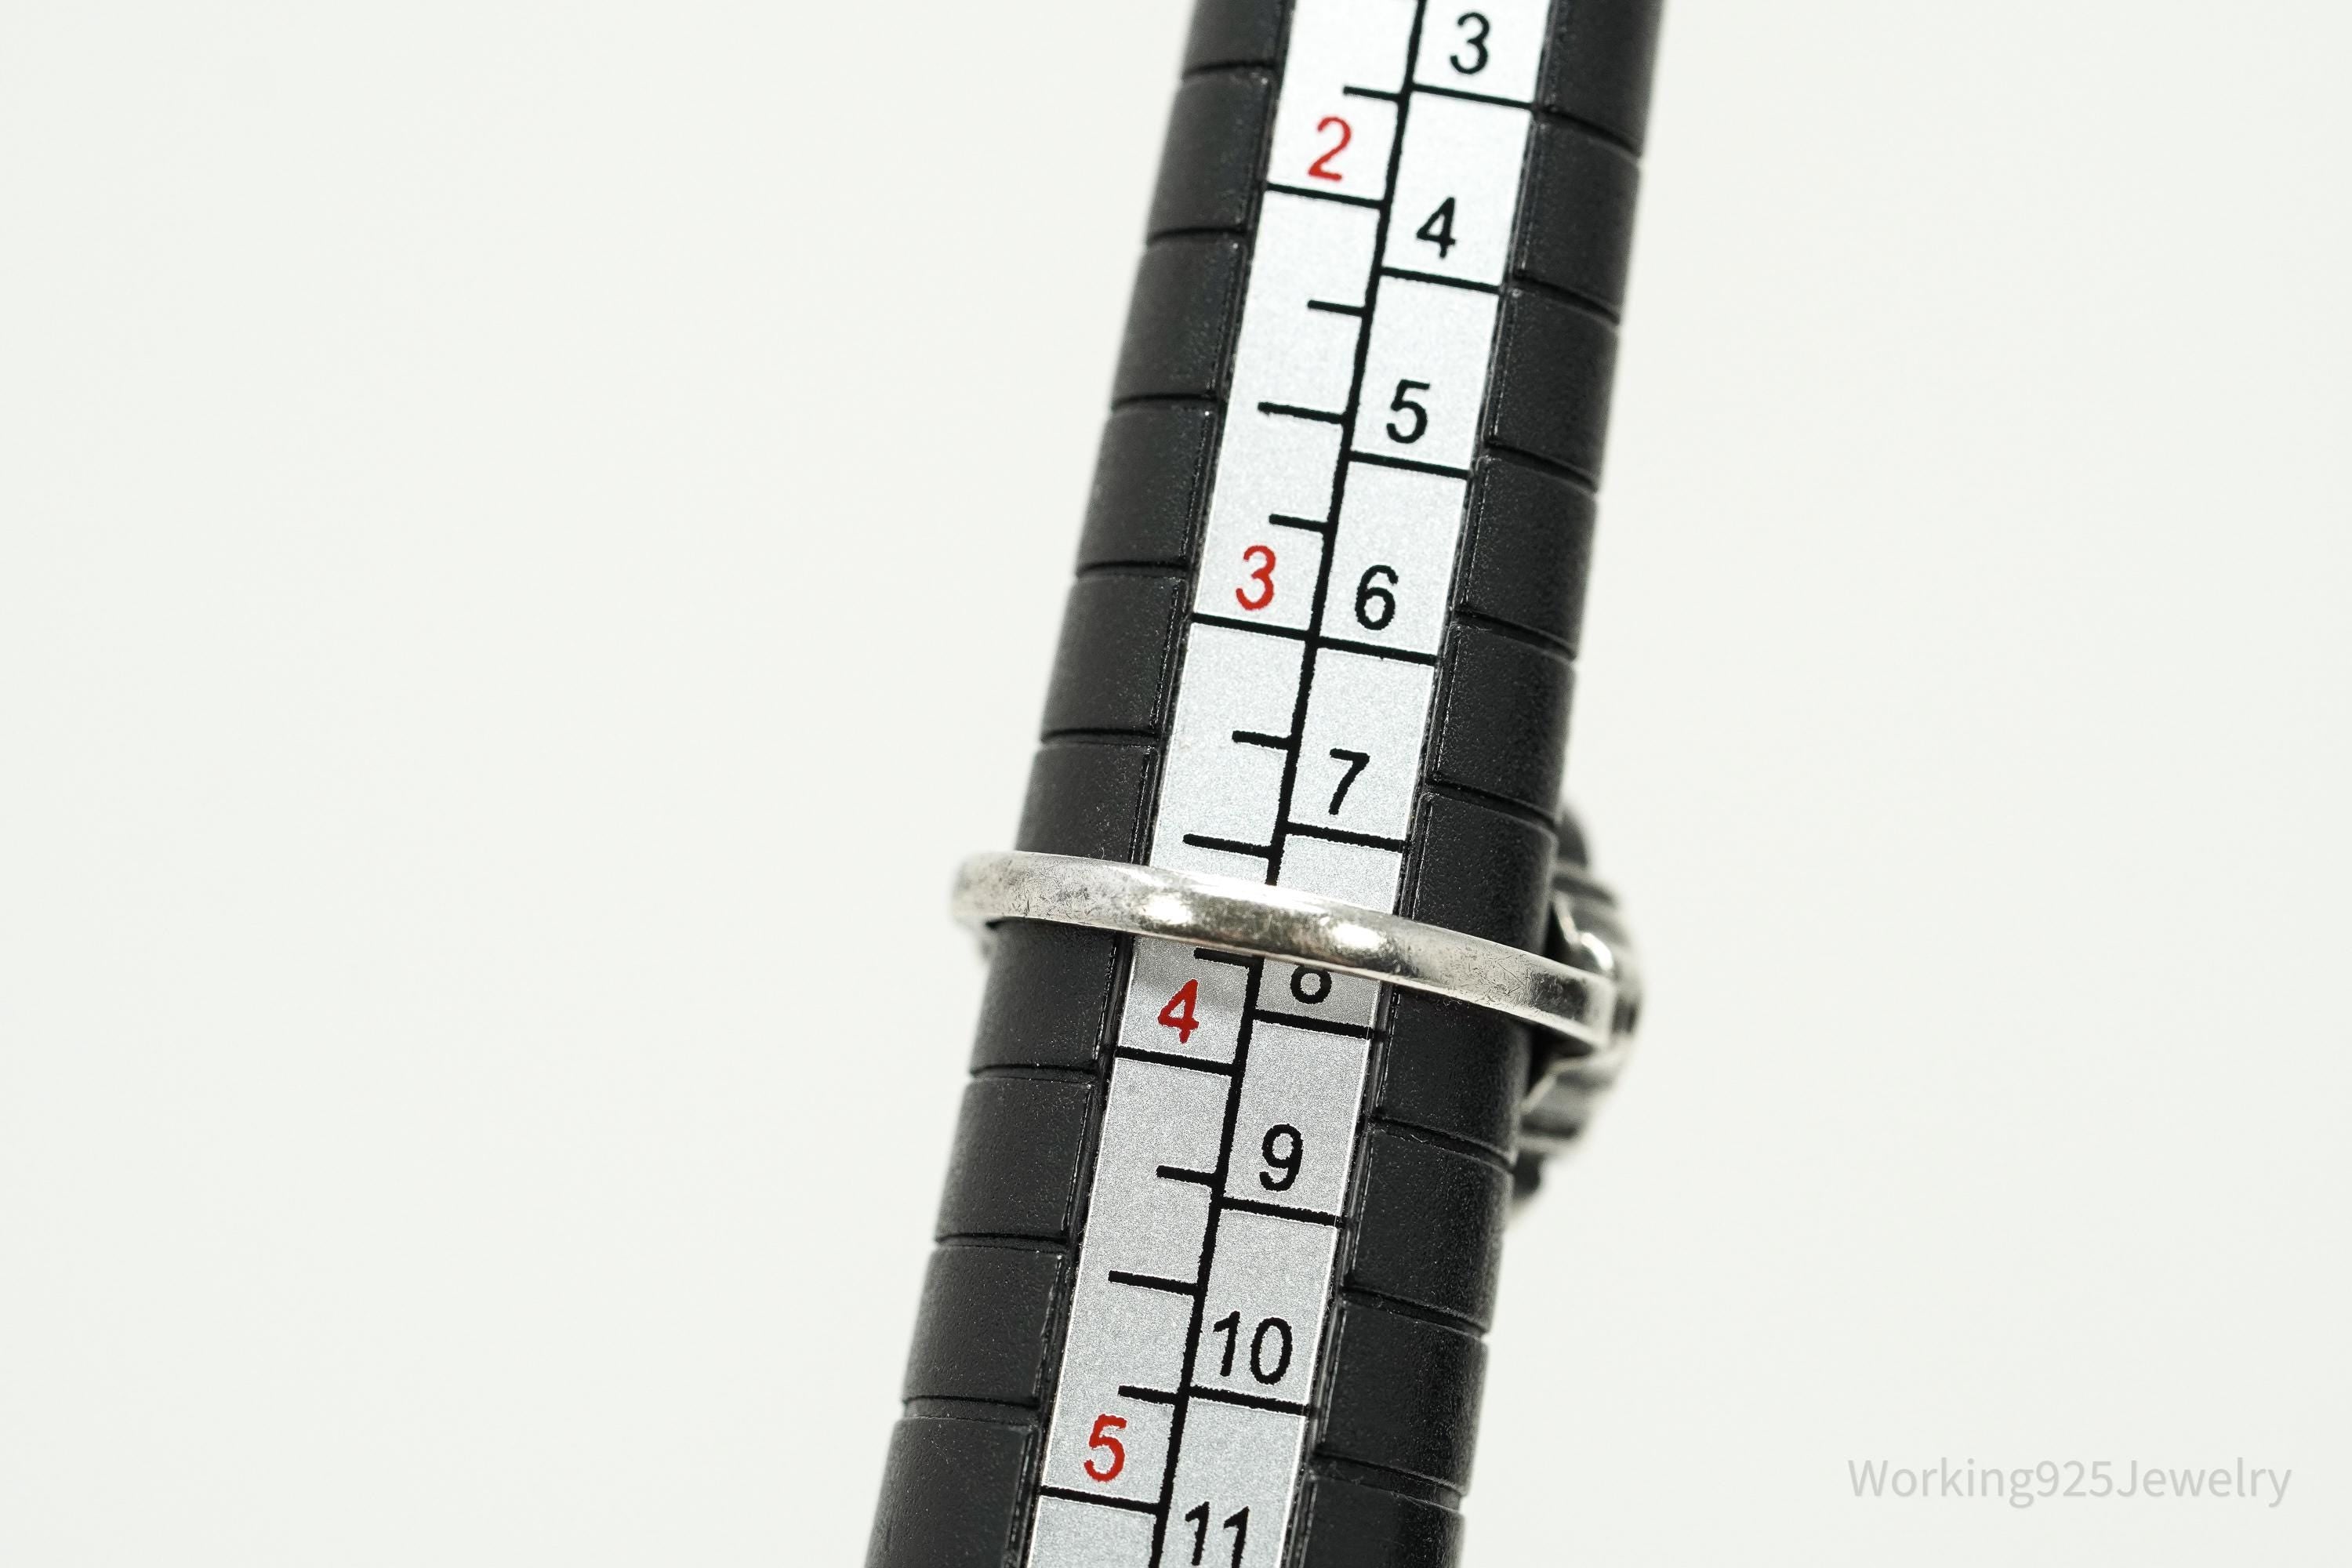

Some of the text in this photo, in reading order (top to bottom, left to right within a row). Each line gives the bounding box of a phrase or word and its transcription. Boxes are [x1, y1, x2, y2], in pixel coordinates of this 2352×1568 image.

[1449, 11, 1490, 76] 3
[1308, 116, 1352, 182] 2
[1415, 196, 1457, 260] 4
[1385, 378, 1431, 445] 5
[1235, 544, 1277, 612] 3
[1353, 564, 1399, 632] 6
[1327, 746, 1371, 817] 7
[1156, 978, 1200, 1045] 4
[1258, 1122, 1305, 1193] 9
[1211, 1309, 1294, 1387] 10
[1083, 1413, 1128, 1483] 5
[1184, 1500, 1250, 1568] 11
